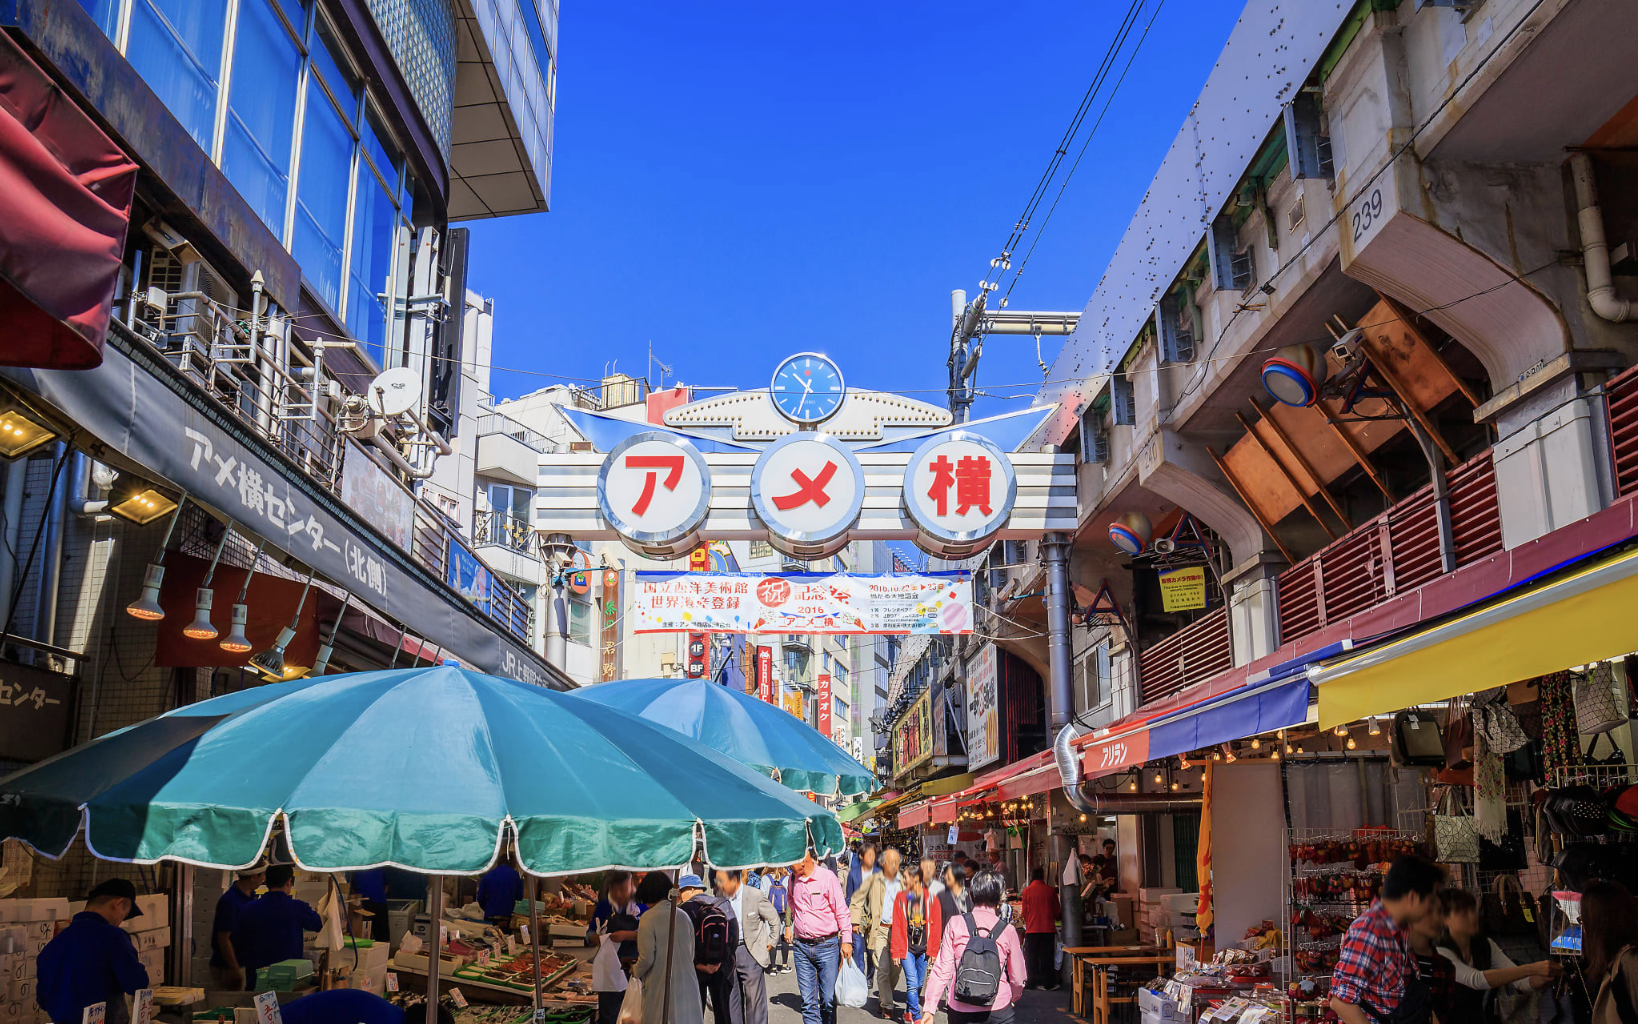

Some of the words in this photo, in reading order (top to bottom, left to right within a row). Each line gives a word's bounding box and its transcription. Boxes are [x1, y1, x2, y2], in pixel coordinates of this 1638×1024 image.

[1352, 188, 1382, 244] 239
[643, 581, 748, 595] 国立西洋美術館
[761, 581, 787, 603] 祝
[794, 584, 851, 605] 記念祭
[651, 596, 740, 609] 世界遺産登録
[798, 606, 824, 614] 2016
[787, 617, 834, 627] アメ横
[691, 644, 703, 652] 1F
[691, 664, 703, 672] BF
[819, 680, 829, 721] カラオケ
[1101, 742, 1128, 768] アリラン
